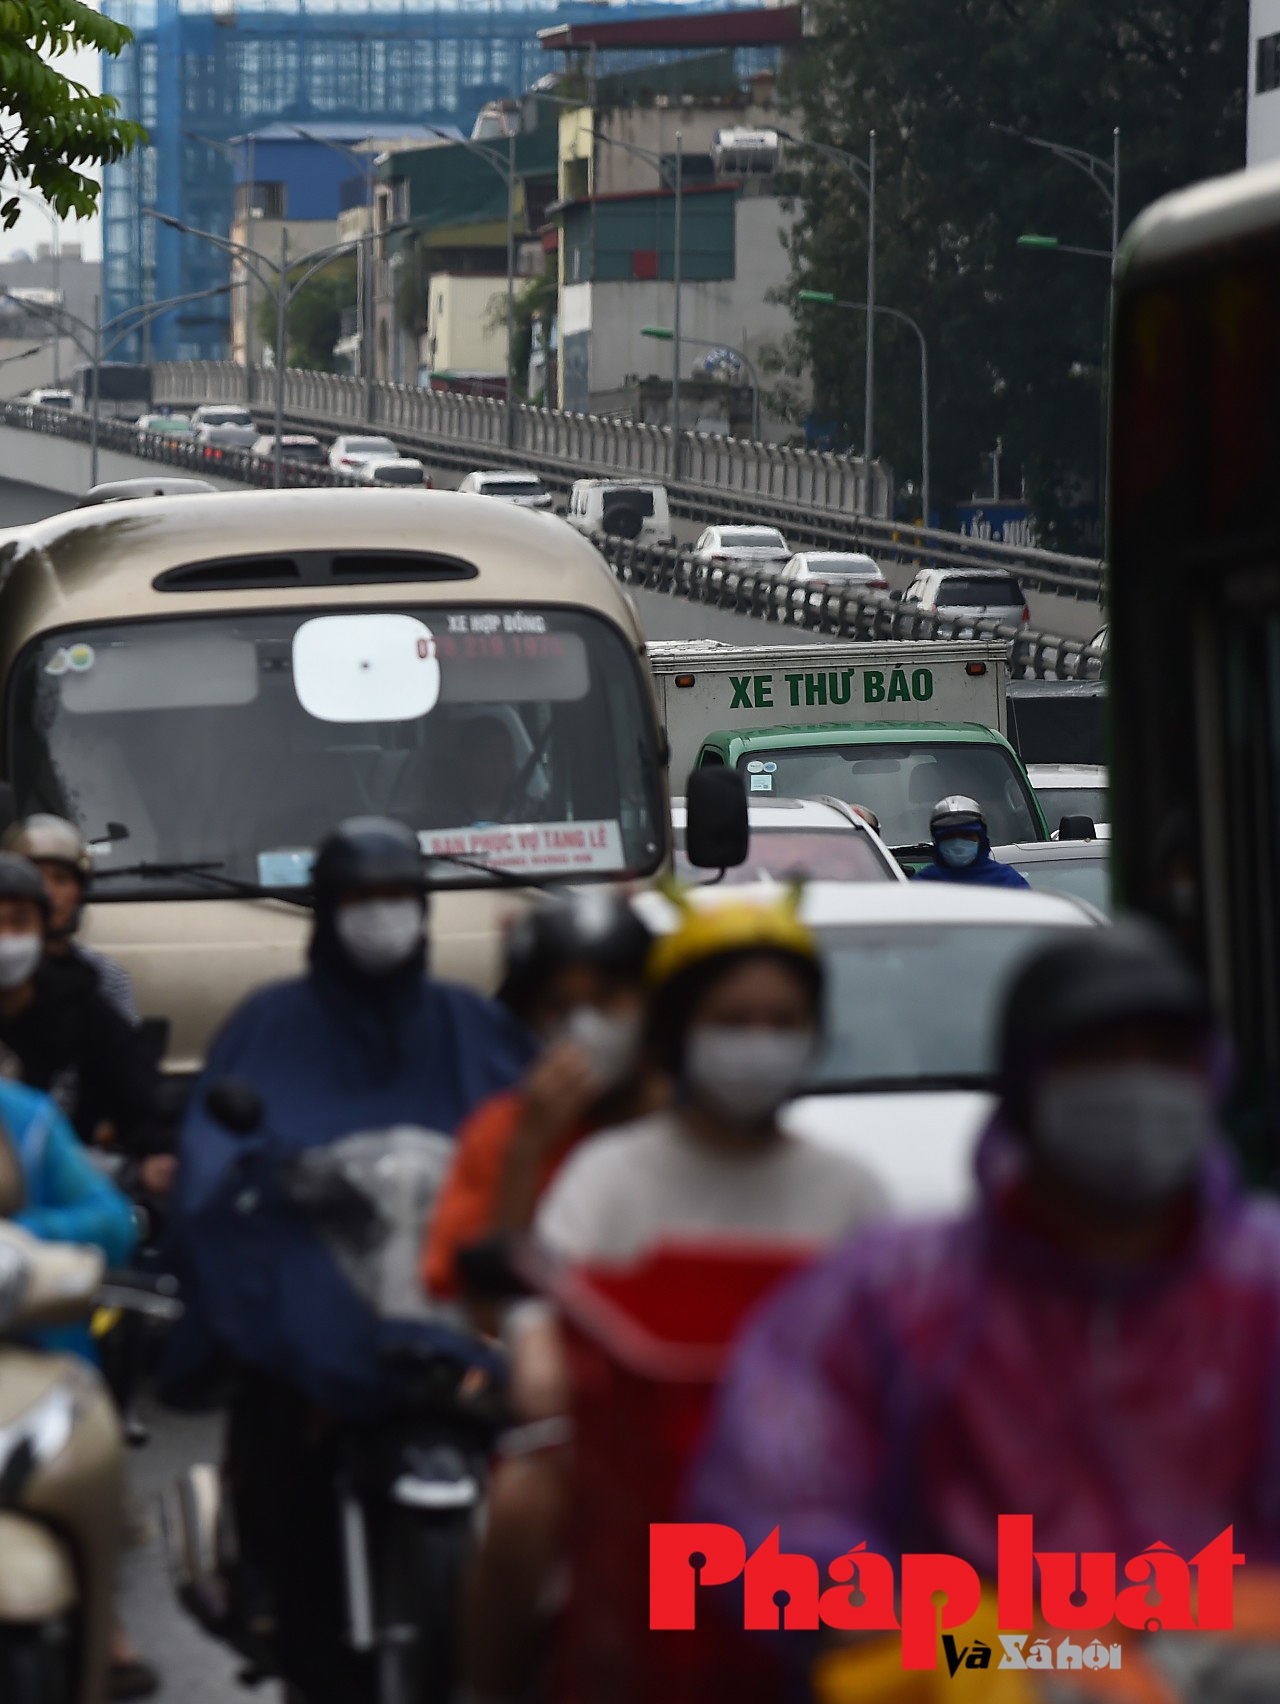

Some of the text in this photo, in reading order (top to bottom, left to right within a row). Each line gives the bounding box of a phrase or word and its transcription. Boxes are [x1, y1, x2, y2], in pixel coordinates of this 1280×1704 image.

[447, 615, 468, 633] XE
[729, 663, 933, 709] XE THƯ BÁO
